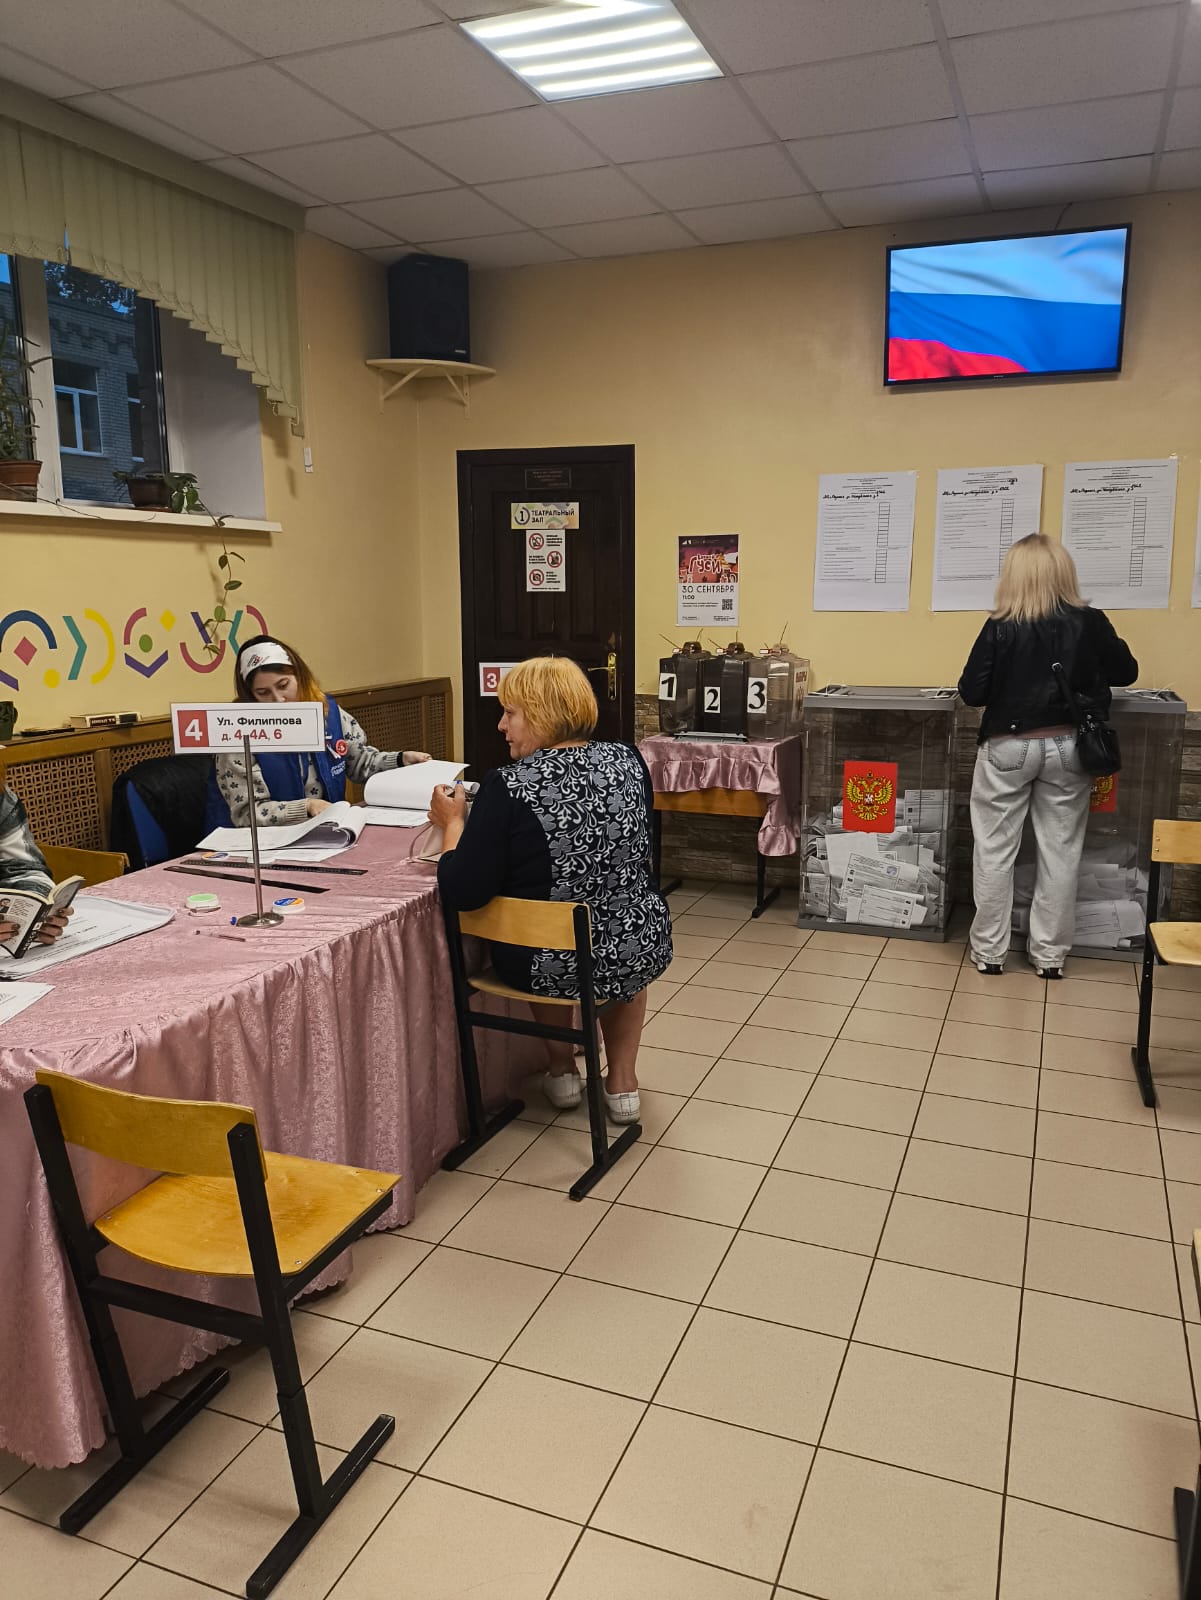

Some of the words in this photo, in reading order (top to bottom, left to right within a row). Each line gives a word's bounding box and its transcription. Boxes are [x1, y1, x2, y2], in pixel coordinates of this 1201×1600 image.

[519, 510, 525, 522] 1
[531, 508, 575, 516] ТЕАТРАЛЬНЫЙ
[682, 585, 694, 593] 30
[696, 585, 735, 593] СЕНТЯБРЯ
[486, 673, 498, 689] 3
[661, 675, 676, 698] 1
[706, 688, 719, 711] 2
[748, 681, 765, 709] 3
[217, 717, 234, 726] Ул.
[237, 716, 302, 726] Филиппова
[184, 718, 203, 741] 4
[221, 733, 231, 741] д.
[273, 728, 282, 740] 6
